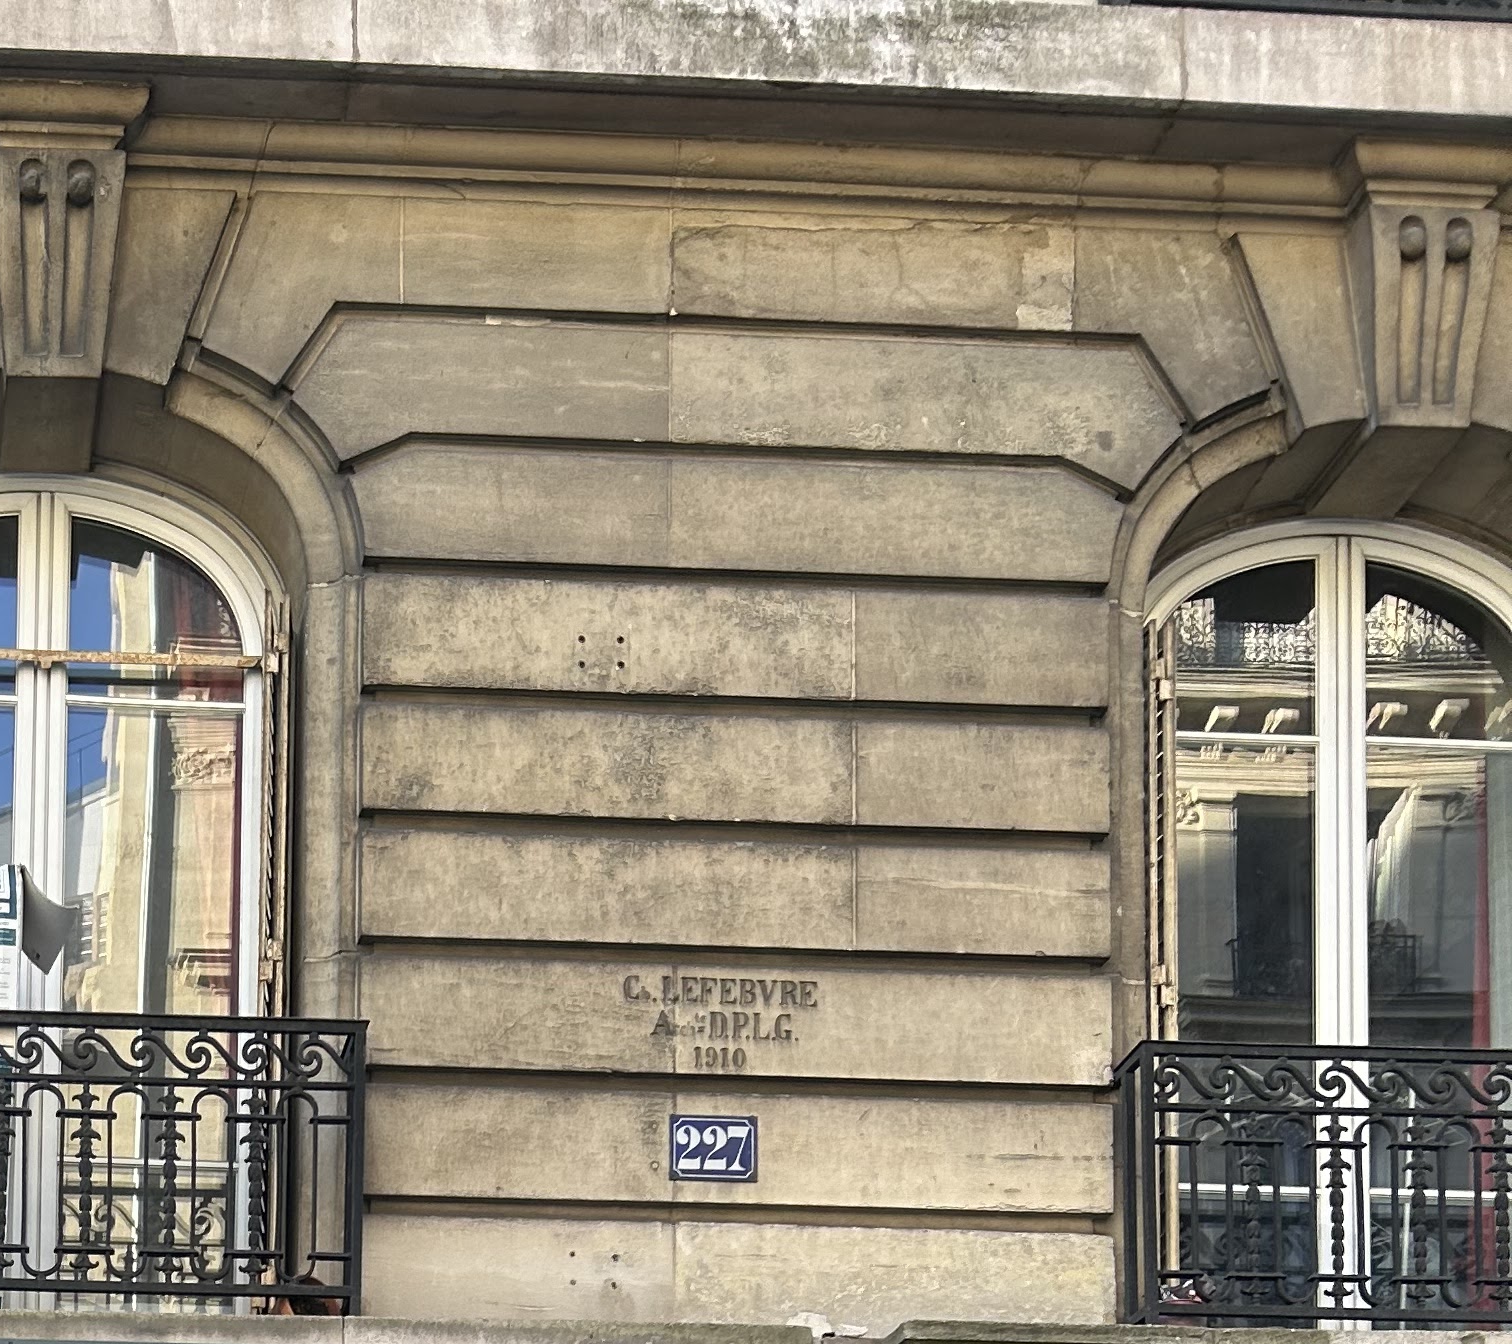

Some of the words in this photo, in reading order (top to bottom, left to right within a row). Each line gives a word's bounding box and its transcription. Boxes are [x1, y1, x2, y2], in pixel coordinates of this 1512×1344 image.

[662, 975, 818, 1008] LEFEBVRE
[693, 1046, 747, 1069] 1910
[676, 1125, 751, 1171] 227
